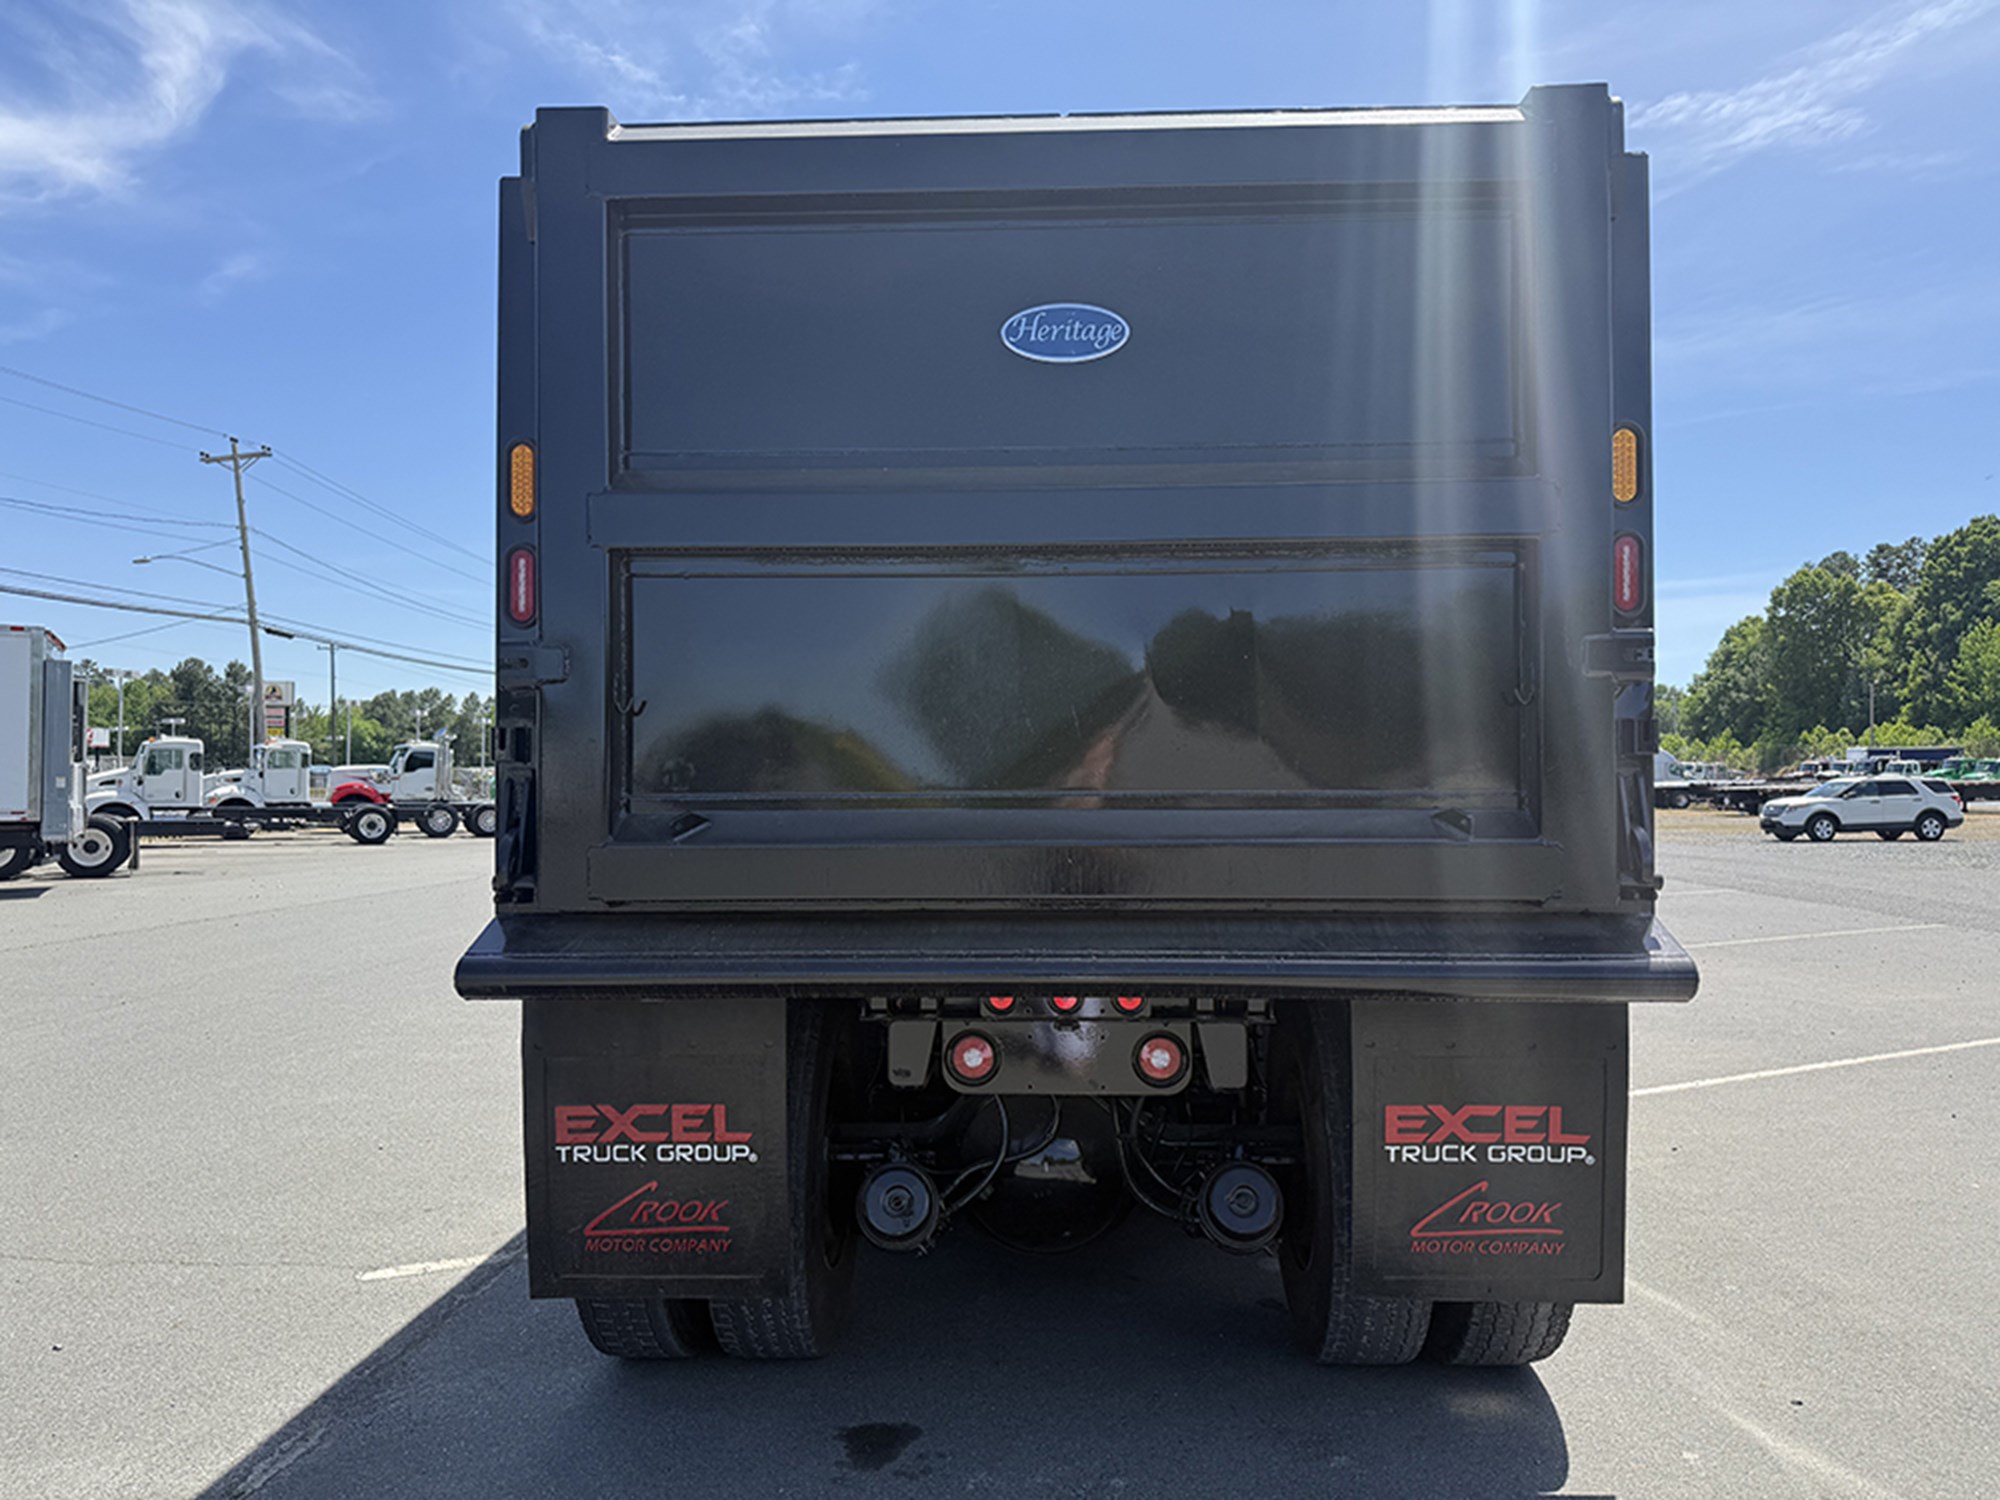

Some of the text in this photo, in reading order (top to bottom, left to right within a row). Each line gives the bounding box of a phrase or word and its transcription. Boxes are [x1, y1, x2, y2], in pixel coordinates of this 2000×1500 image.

[1009, 311, 1122, 350] Heritage
[555, 1104, 752, 1143] EXCEL
[1385, 1105, 1591, 1144] EXCEL
[555, 1144, 648, 1163] TRUCK
[1385, 1145, 1478, 1163] TRUCK
[585, 1238, 732, 1254] MOTOR COMPANY
[1410, 1240, 1565, 1255] MOTOR COMPANY
